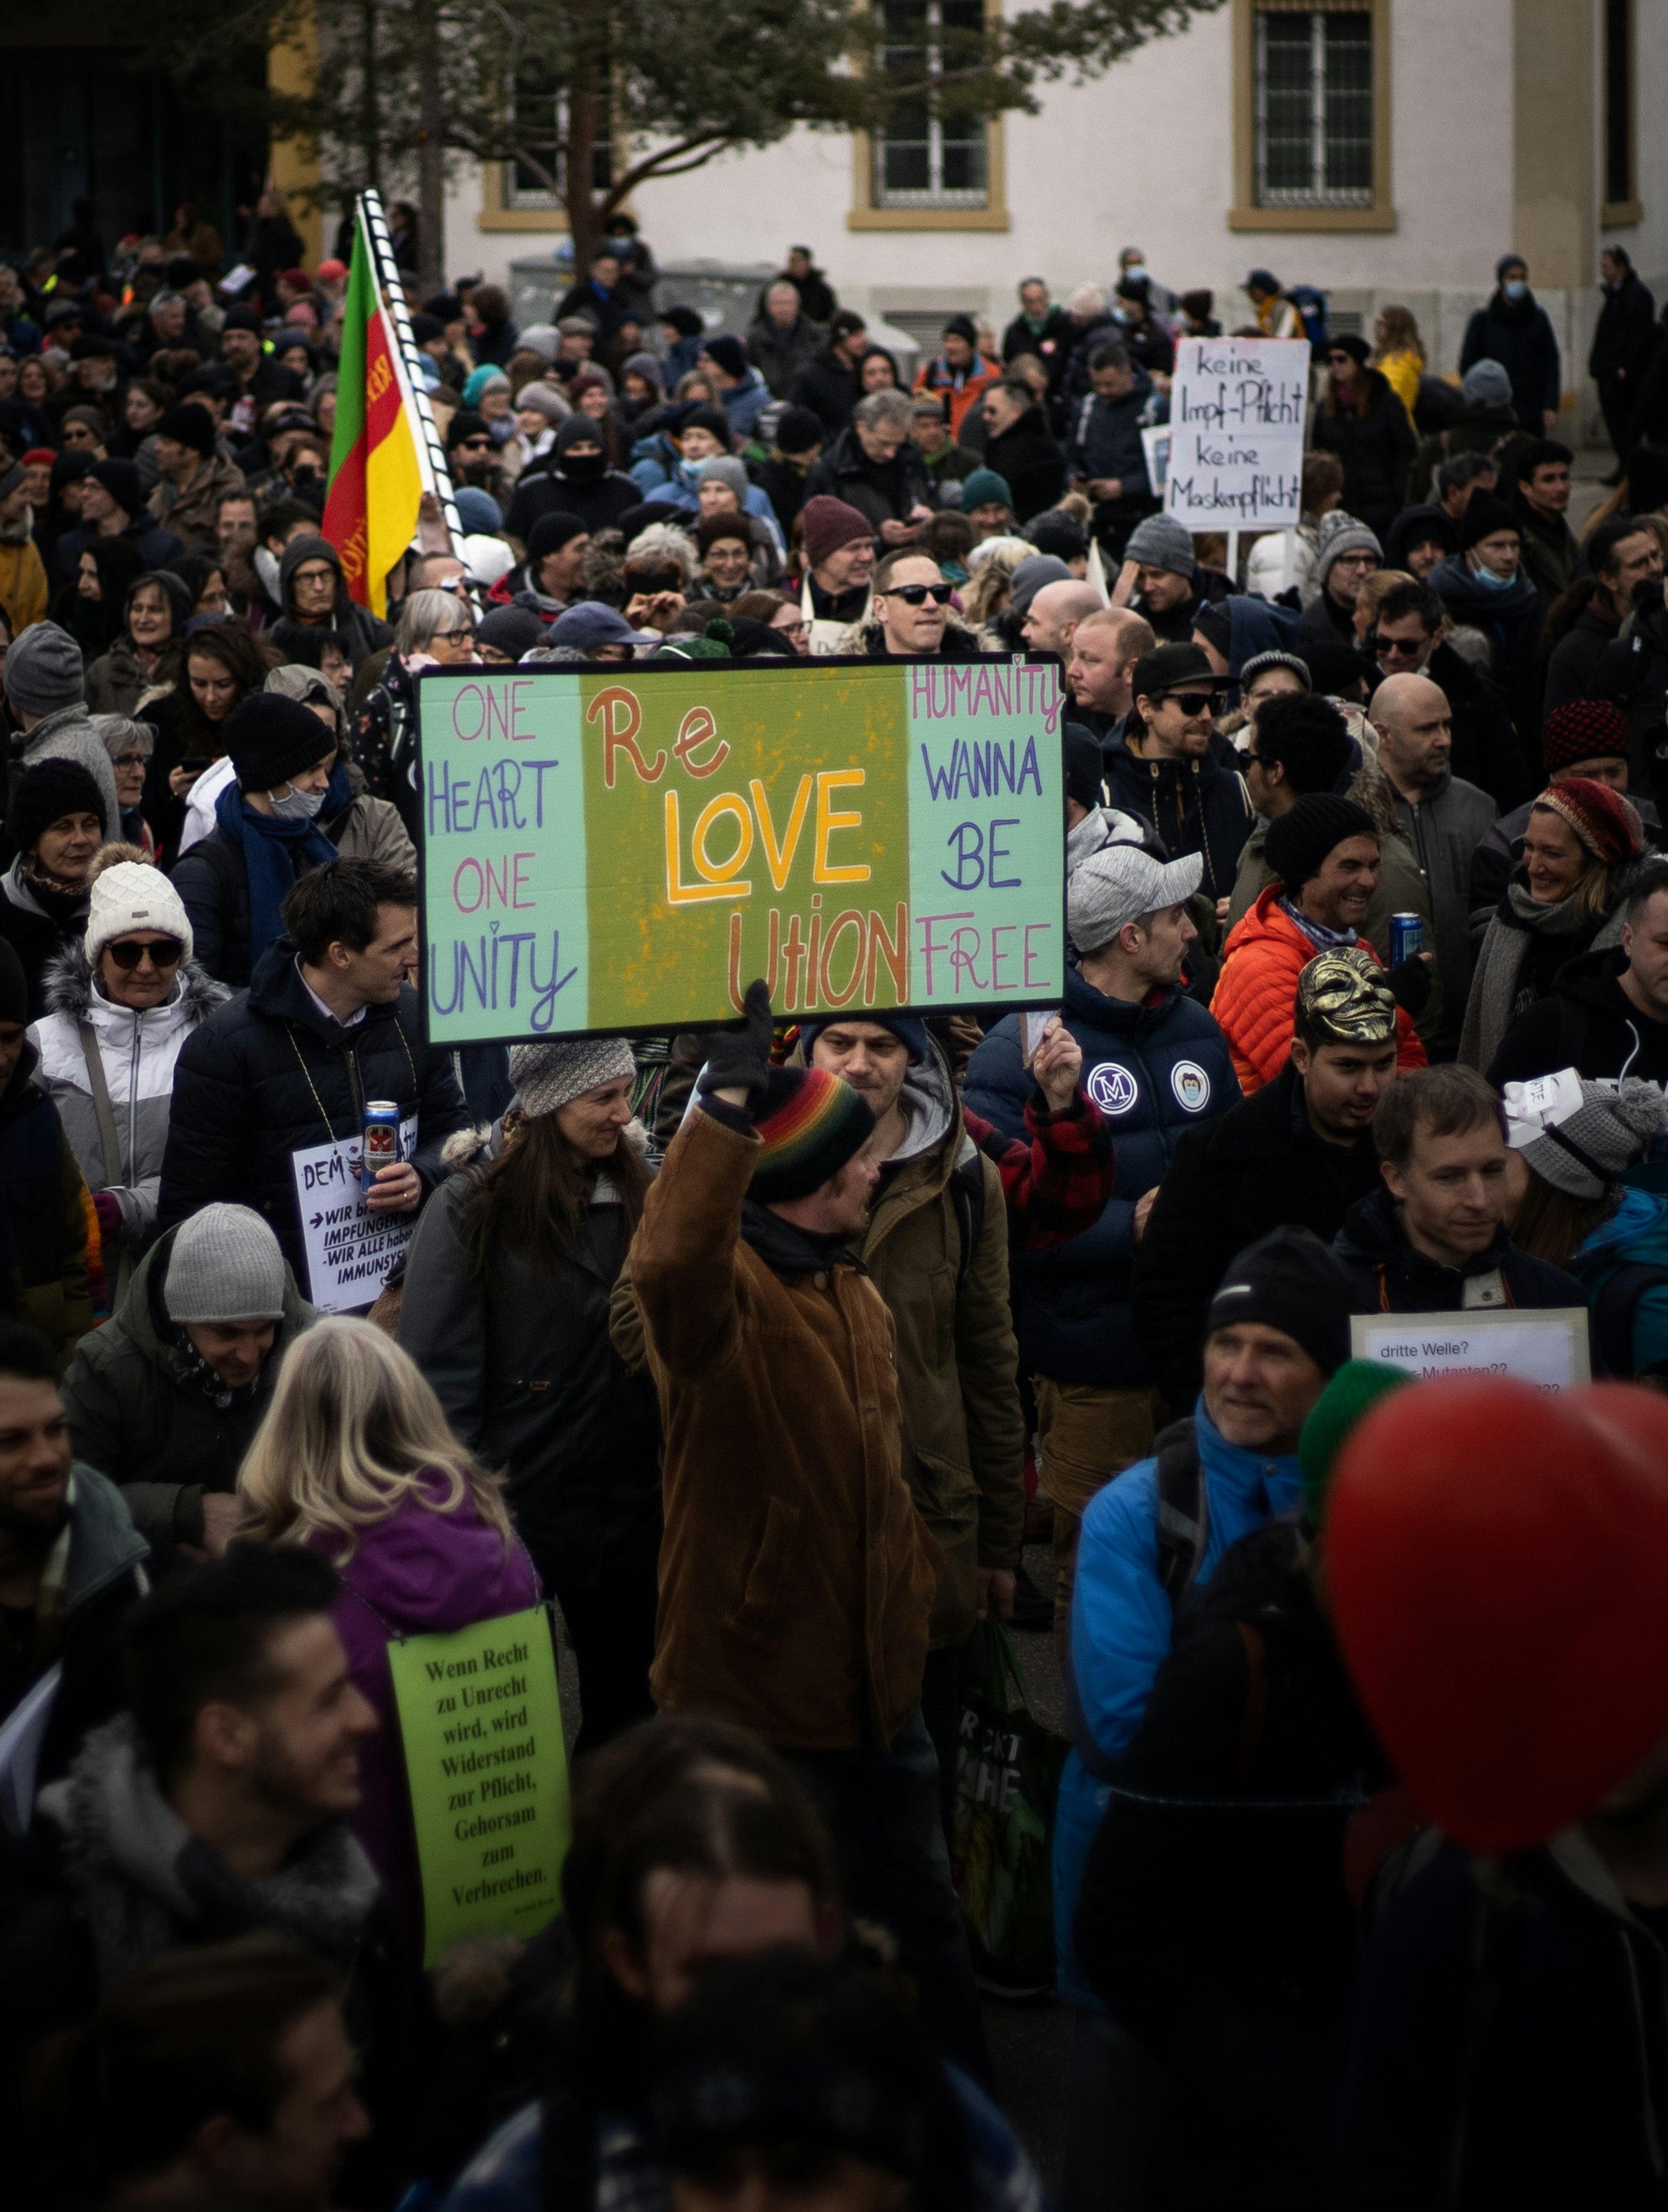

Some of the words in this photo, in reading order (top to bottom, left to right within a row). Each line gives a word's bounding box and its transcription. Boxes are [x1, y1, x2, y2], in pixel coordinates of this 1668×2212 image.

[1197, 345, 1264, 375] keine
[1196, 434, 1259, 466] keine
[1171, 474, 1300, 519] Maskenpflicht
[452, 681, 536, 743] ONE
[587, 685, 731, 789] Re
[921, 734, 1043, 802] WANNA
[428, 758, 559, 836] HEART
[664, 768, 871, 904] LOVE
[940, 819, 1022, 890] BE
[452, 852, 537, 914] ONE
[916, 910, 1052, 997] FREE
[324, 1213, 398, 1247] IMPFUNGEN
[325, 1206, 352, 1225] WIR
[357, 1236, 385, 1258] ALLE
[1381, 1344, 1418, 1359] dritte
[1422, 1341, 1470, 1357] Welle?
[425, 1659, 478, 1683] Wenn
[483, 1642, 529, 1671] Recht
[436, 1696, 457, 1715] zu
[462, 1675, 527, 1707] Unrecht
[443, 1718, 488, 1745] wird,
[491, 1706, 528, 1733] wird
[441, 1736, 536, 1778] Widerstand
[449, 1791, 474, 1811] zur
[480, 1772, 537, 1802] Pflicht,
[454, 1806, 536, 1841] Gehorsam
[482, 1845, 514, 1867] zum
[453, 1869, 547, 1907] Verbrechen.
